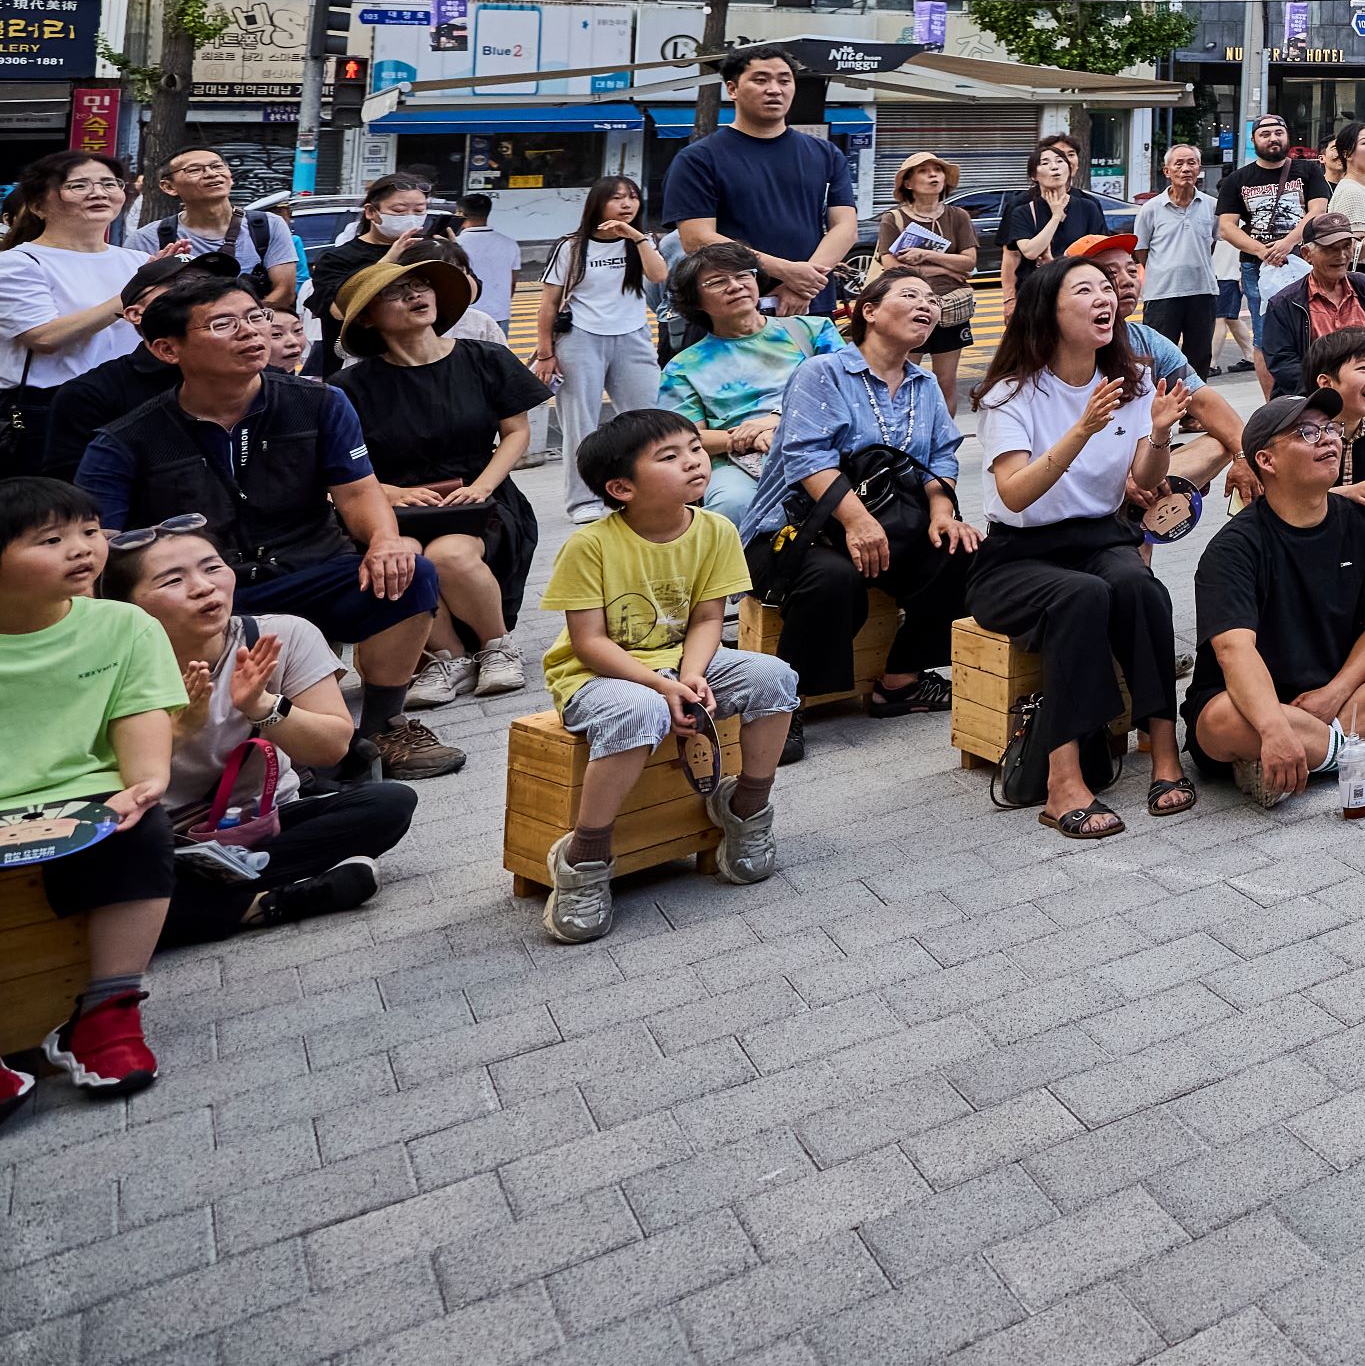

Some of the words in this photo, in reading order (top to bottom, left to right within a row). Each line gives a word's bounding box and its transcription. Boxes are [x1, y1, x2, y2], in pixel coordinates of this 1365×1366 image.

[828, 47, 864, 61] Nice
[1307, 49, 1346, 63] HOTEL
[836, 60, 878, 71] junggu
[190, 85, 229, 95] 금대납
